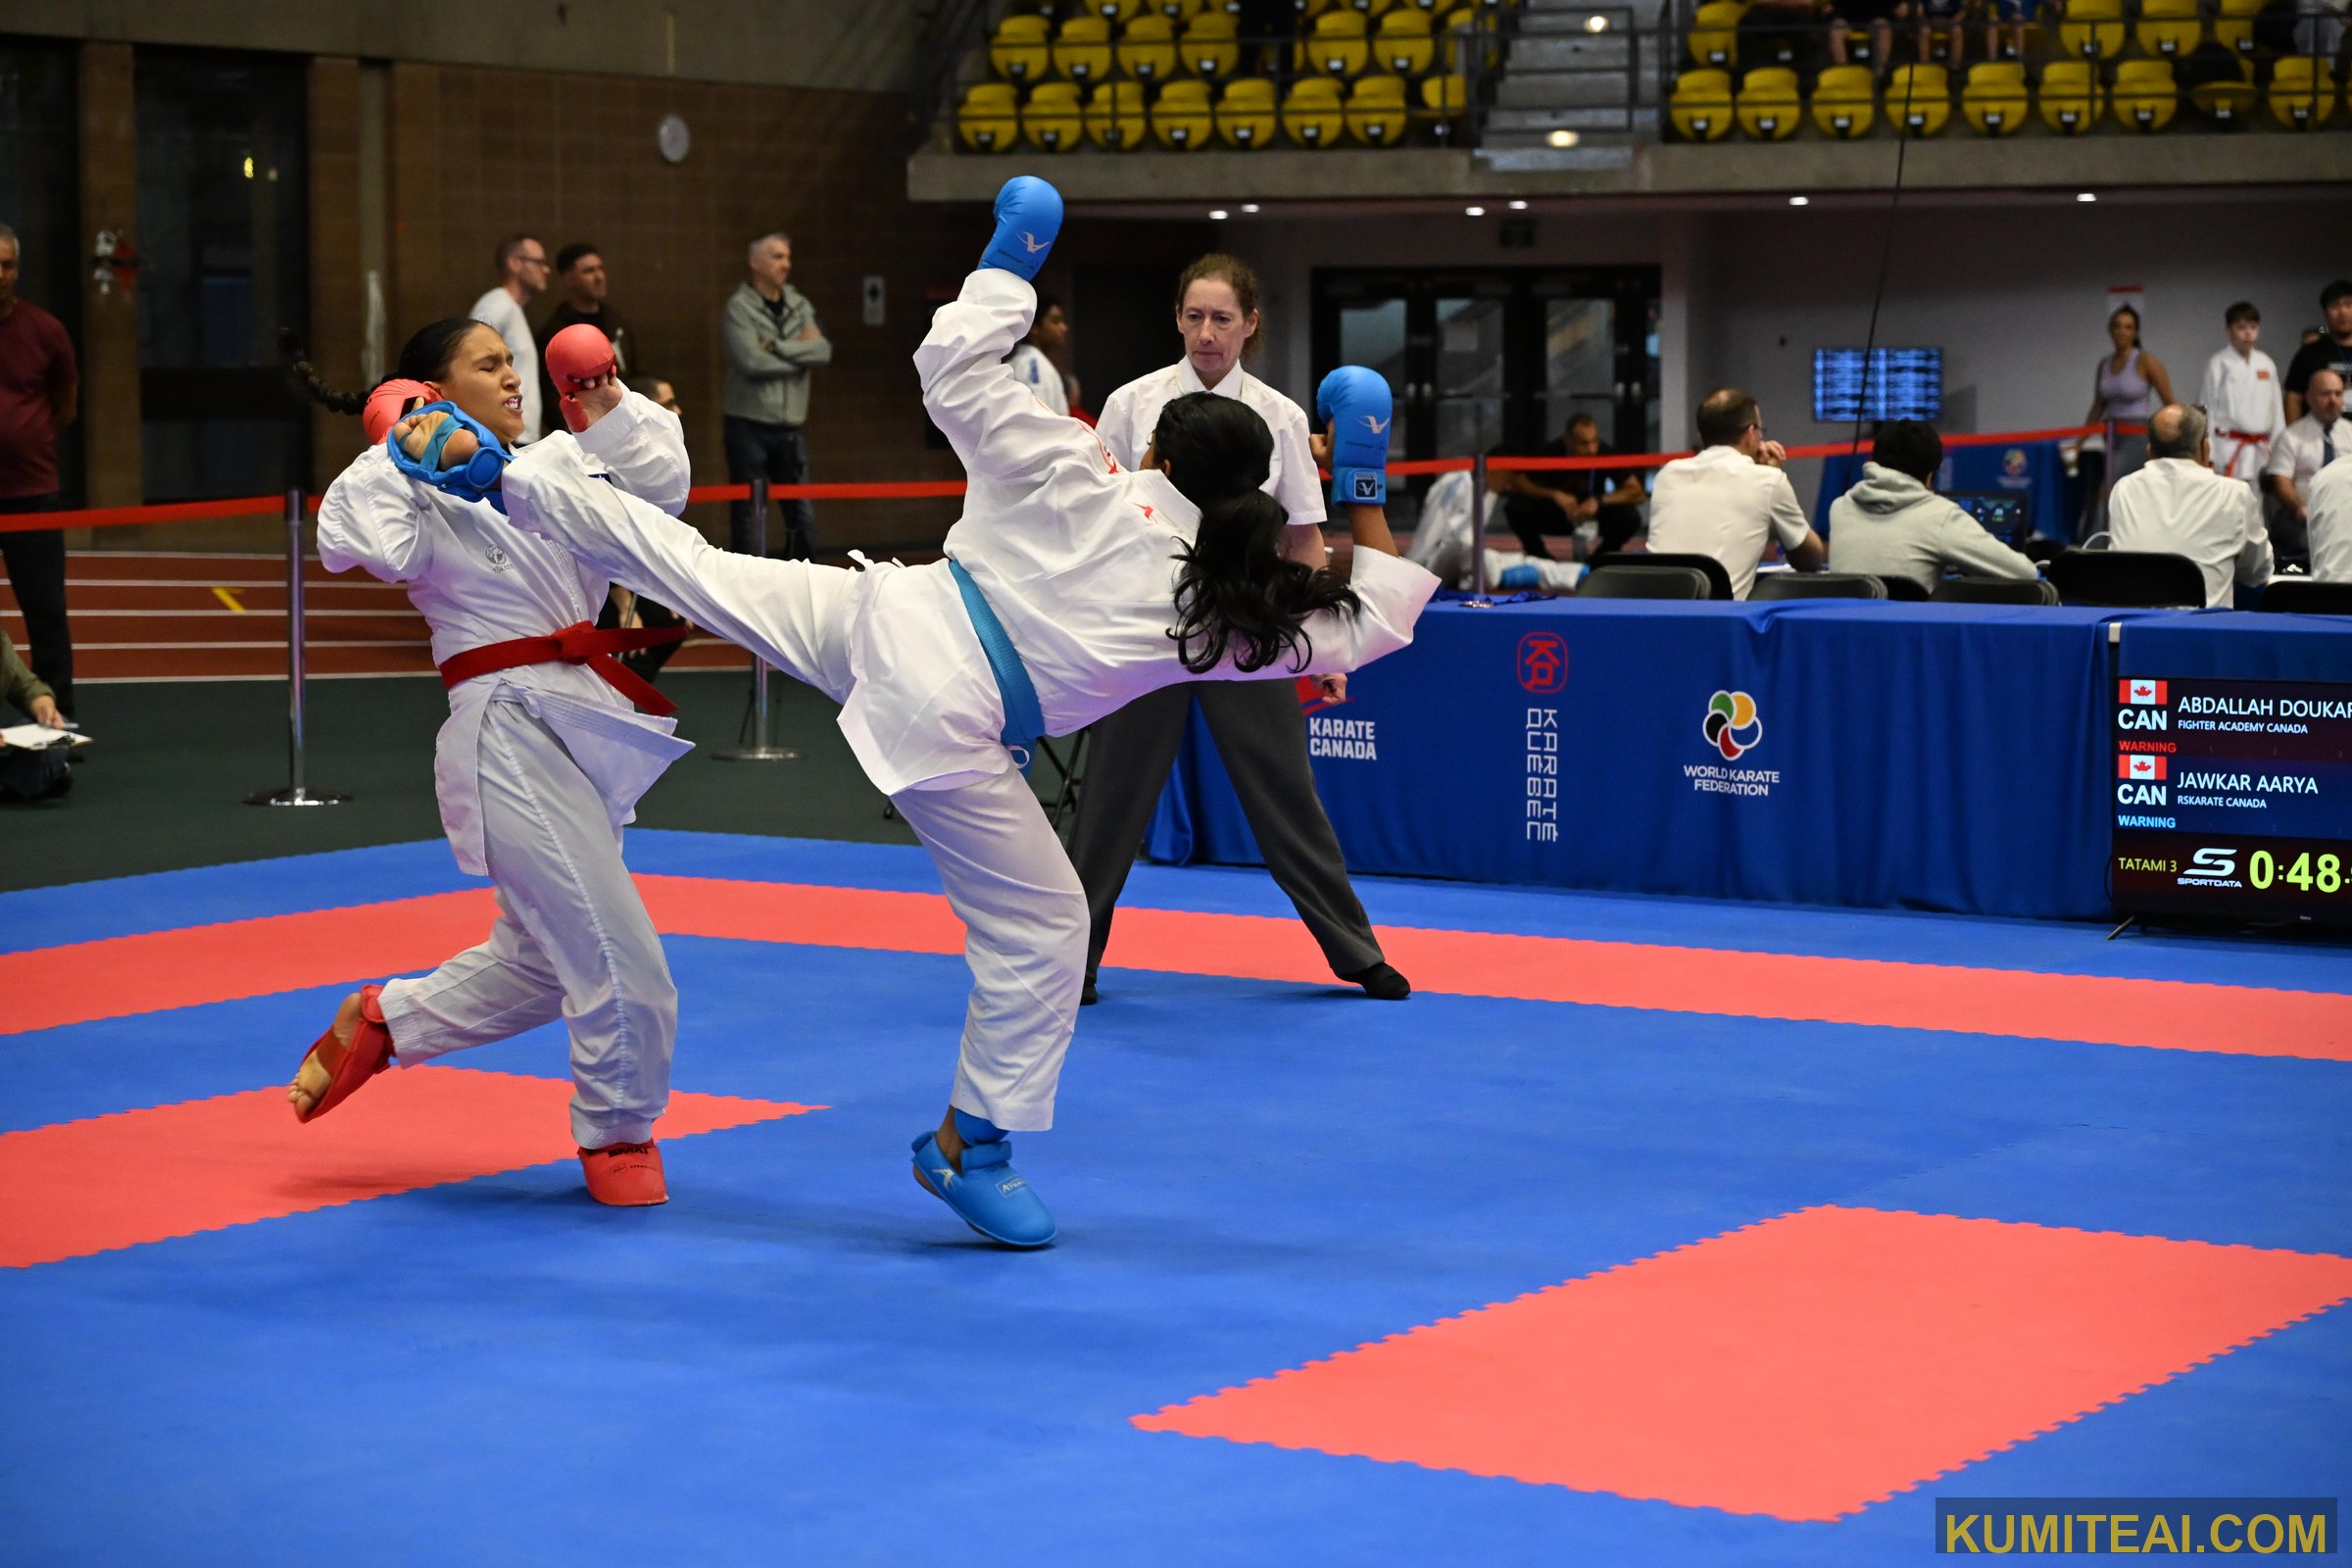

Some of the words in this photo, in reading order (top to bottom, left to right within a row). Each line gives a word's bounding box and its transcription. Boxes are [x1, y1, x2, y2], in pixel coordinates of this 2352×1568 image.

[2178, 697, 2274, 716] ABDALLAH
[1309, 717, 1376, 740] KARATE
[2118, 709, 2168, 731] CAN
[2178, 719, 2216, 731] FIGHTER
[2218, 721, 2265, 733] ACADEMY
[2267, 722, 2308, 734] CANADA
[1309, 738, 1377, 760] CANADA
[2119, 740, 2177, 754] WARNING
[1684, 765, 1728, 779] WORLD
[1730, 769, 1780, 783] KARATE
[2177, 771, 2252, 791] JAWKAR
[2256, 775, 2319, 794] AARYA
[1694, 779, 1769, 796] FEDERATION
[2117, 783, 2167, 807] CAN
[2178, 795, 2224, 807] RSKARATE
[2226, 797, 2267, 808] CANADA
[2118, 814, 2177, 828] WARNING
[2118, 858, 2166, 872] TATAMI
[2170, 859, 2178, 872] 3
[2249, 850, 2352, 894] 0:48.
[2177, 877, 2242, 888] SPORTDATA
